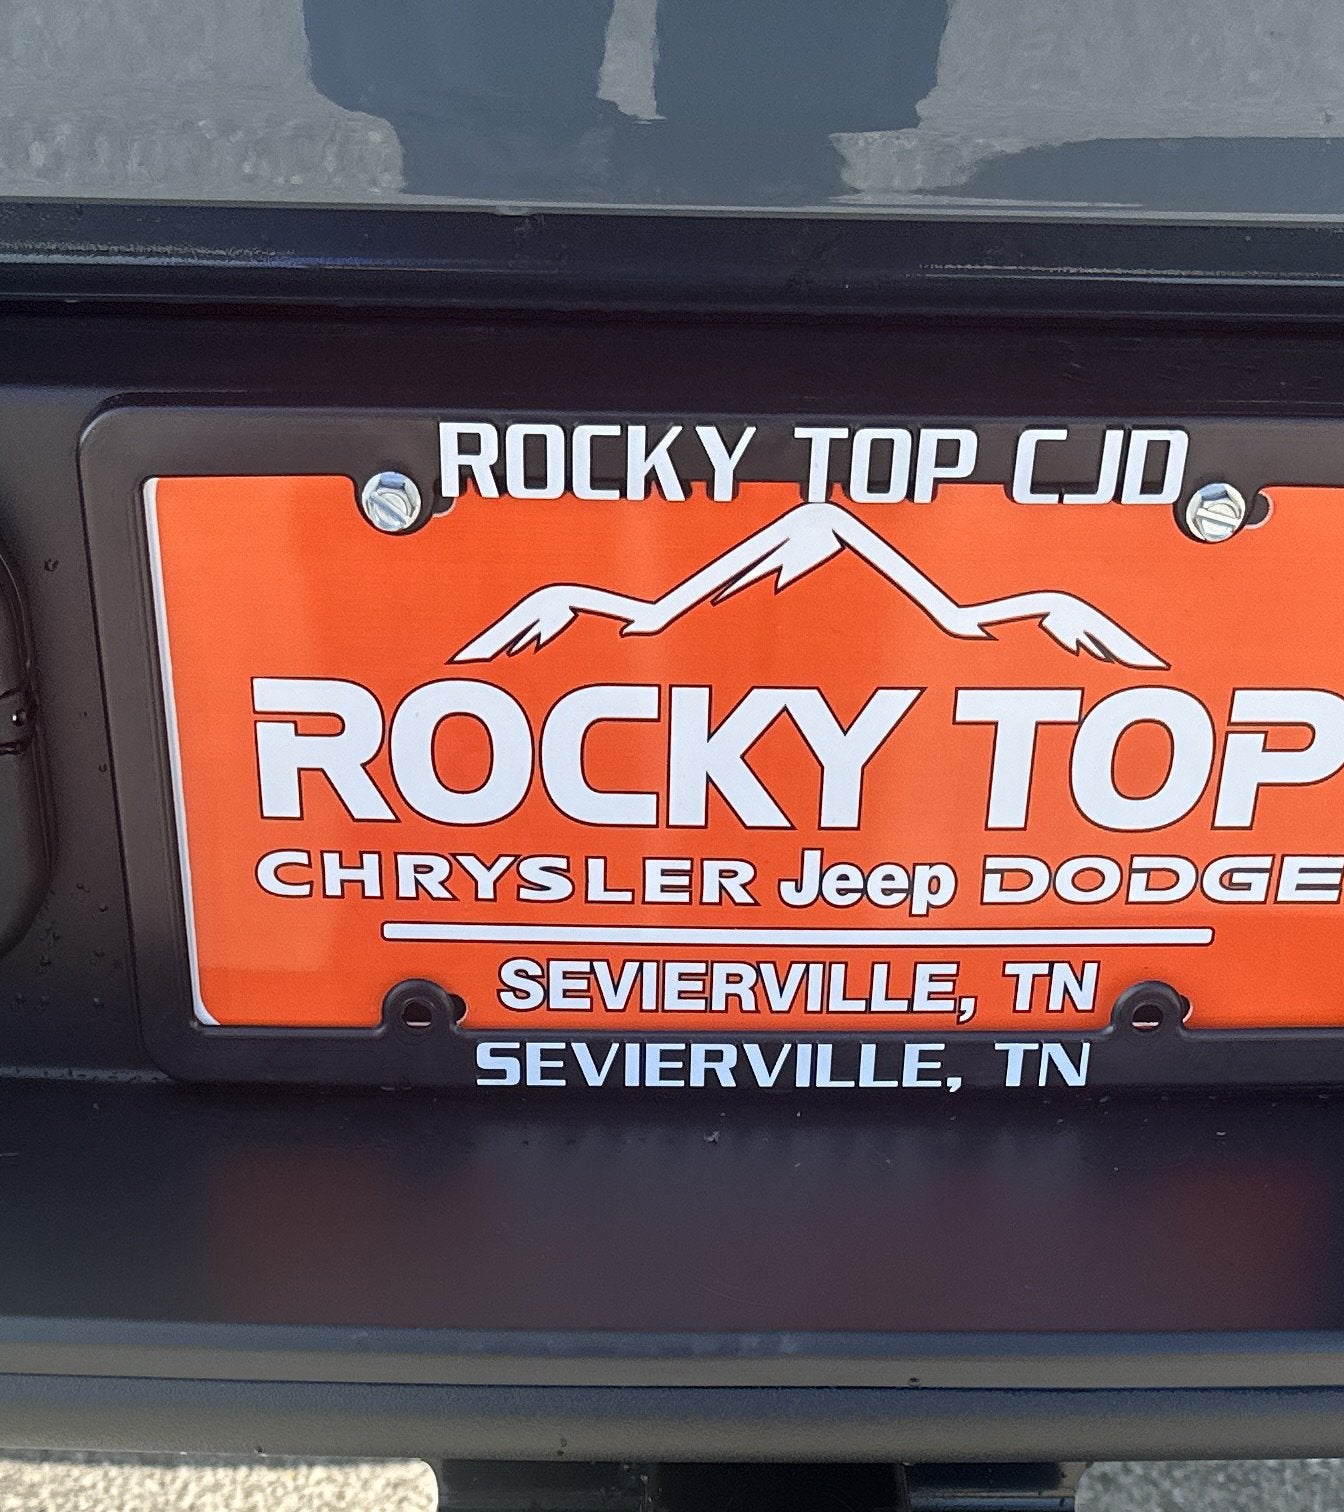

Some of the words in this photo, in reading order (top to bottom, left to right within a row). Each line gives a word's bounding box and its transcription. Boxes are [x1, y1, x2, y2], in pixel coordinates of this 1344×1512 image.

[438, 422, 757, 503] ROCKY
[793, 426, 978, 504] TOP
[1011, 428, 1190, 505] CJD
[251, 676, 927, 831] ROCKY
[256, 848, 761, 906] CHRYSLER
[777, 847, 957, 917] Jeep
[496, 956, 977, 1025] SEVIERVILLE,
[1003, 960, 1101, 1014] TN
[475, 1041, 963, 1093] SEVIERVILLE,
[993, 1041, 1091, 1088] TN
